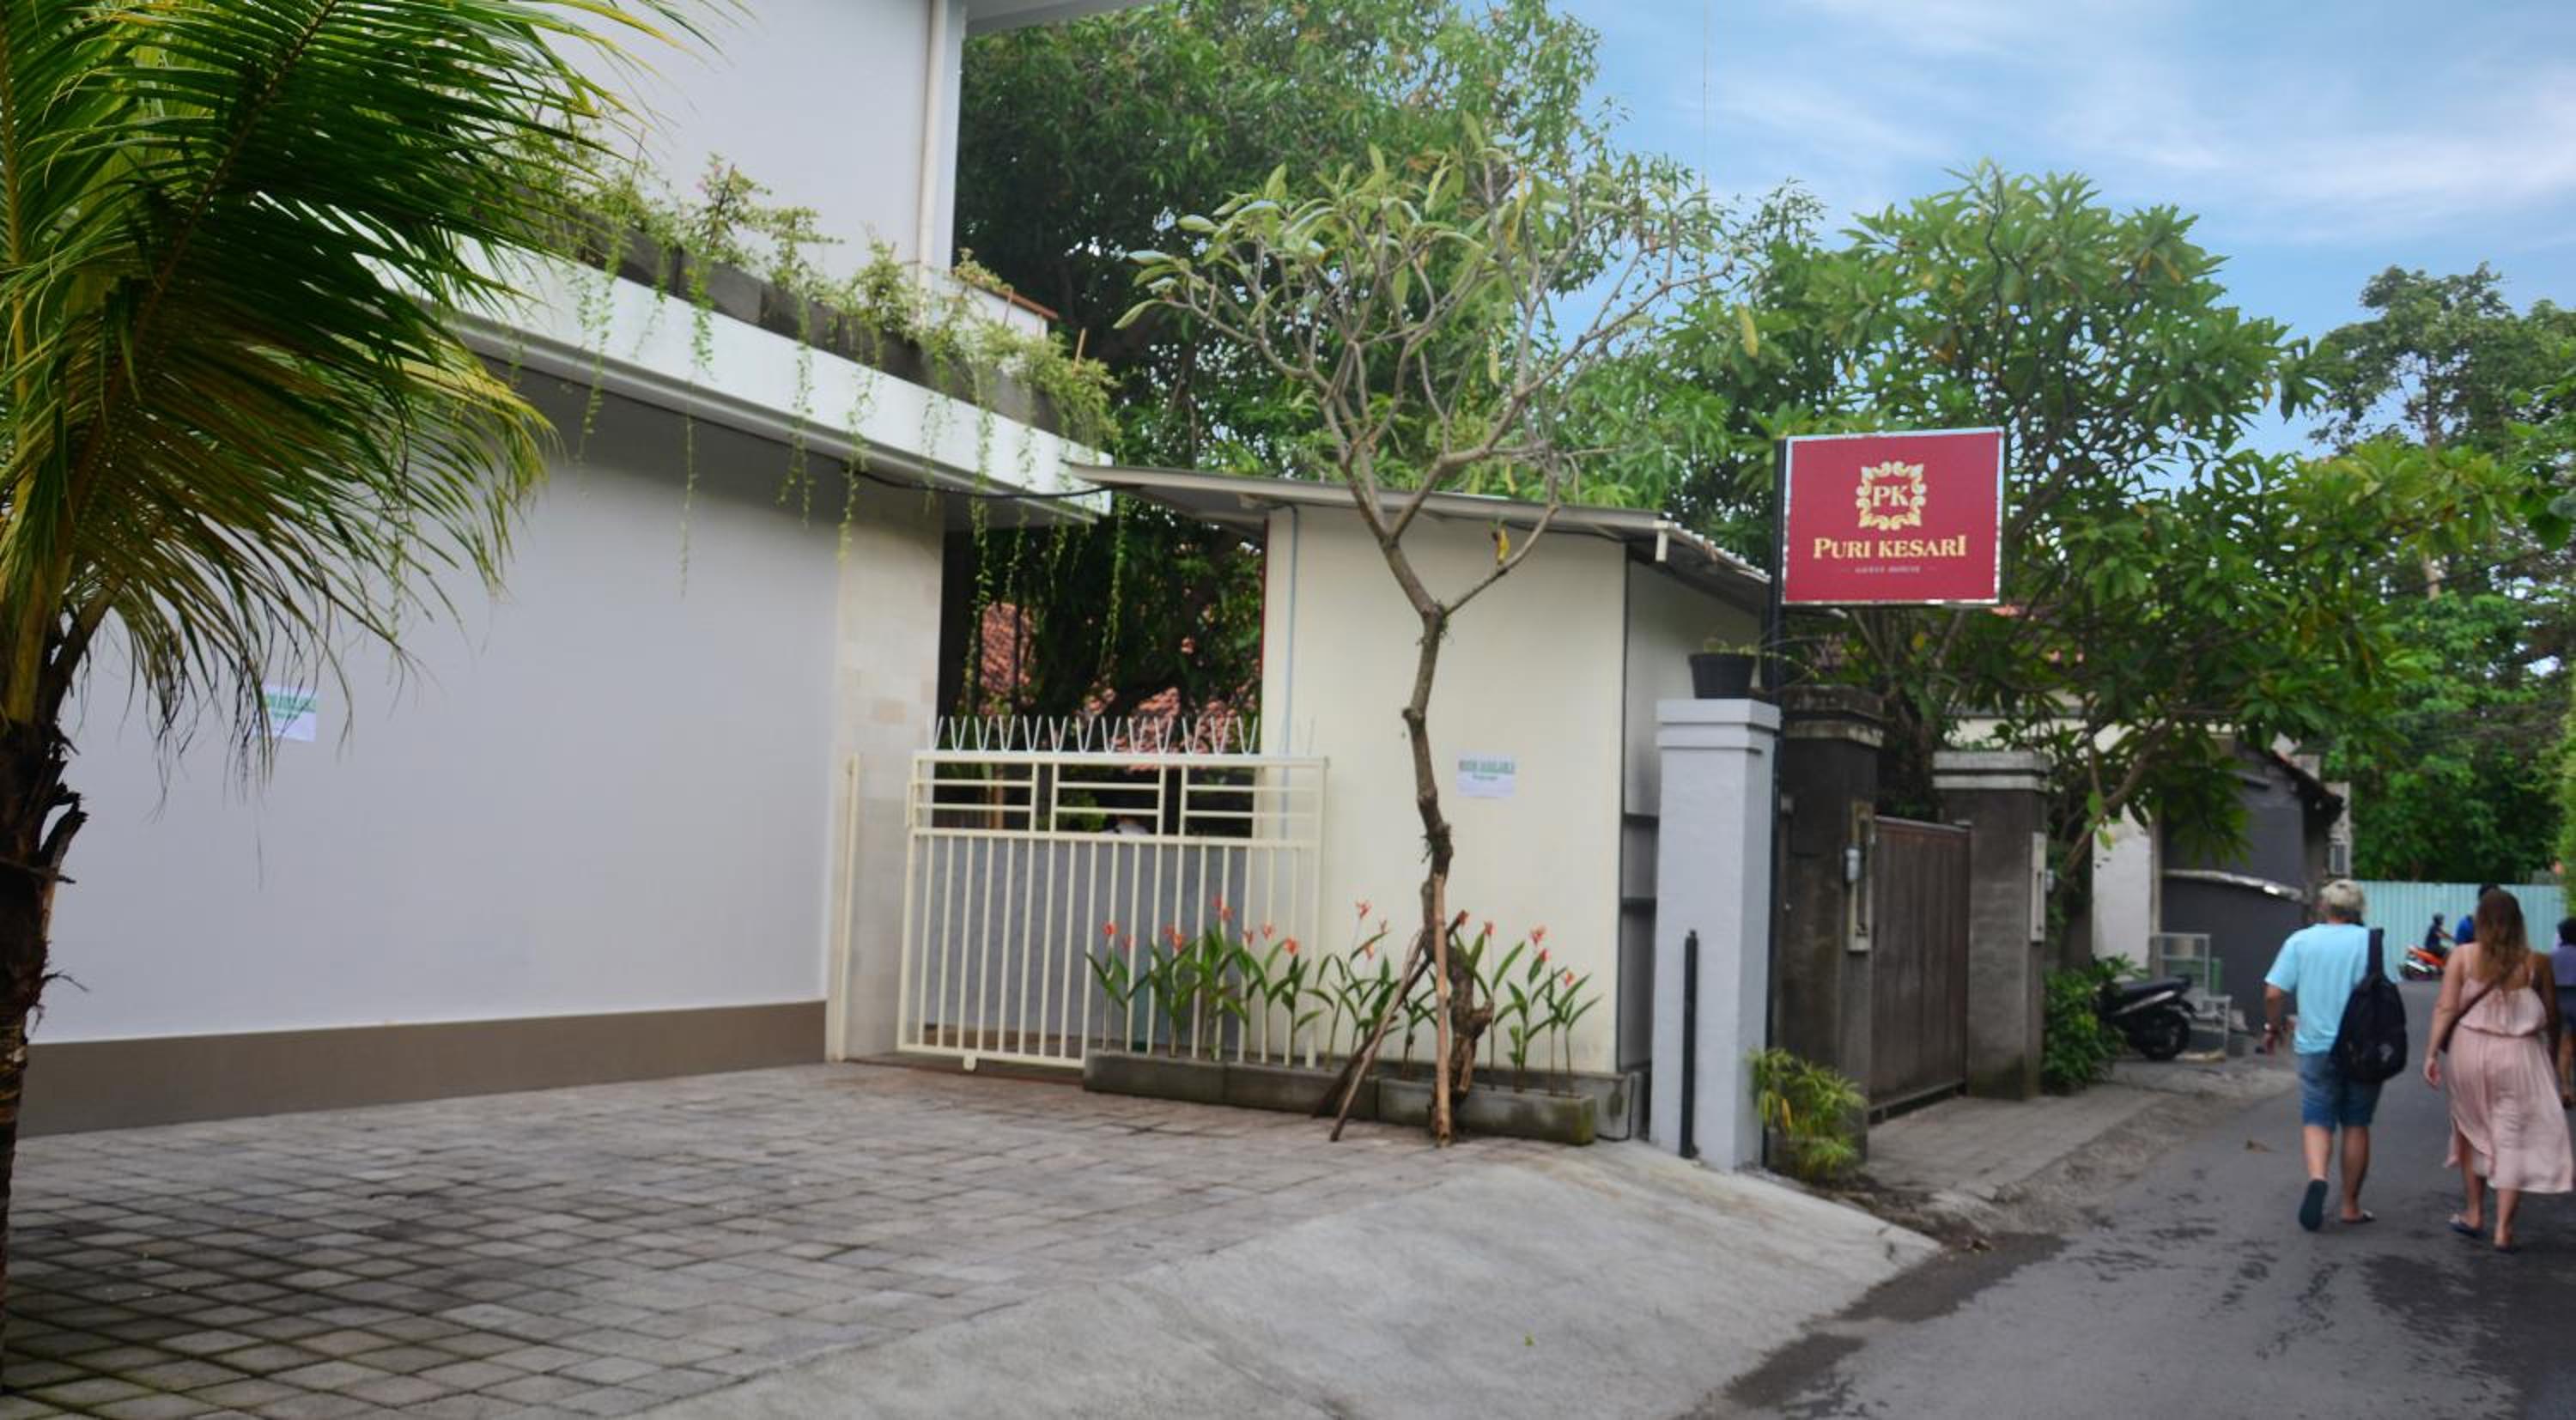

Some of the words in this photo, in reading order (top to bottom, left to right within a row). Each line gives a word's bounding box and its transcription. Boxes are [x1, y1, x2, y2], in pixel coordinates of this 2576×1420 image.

[1873, 485, 1909, 507] PK
[1814, 537, 1871, 559] PURI
[1879, 535, 1966, 558] KESARI
